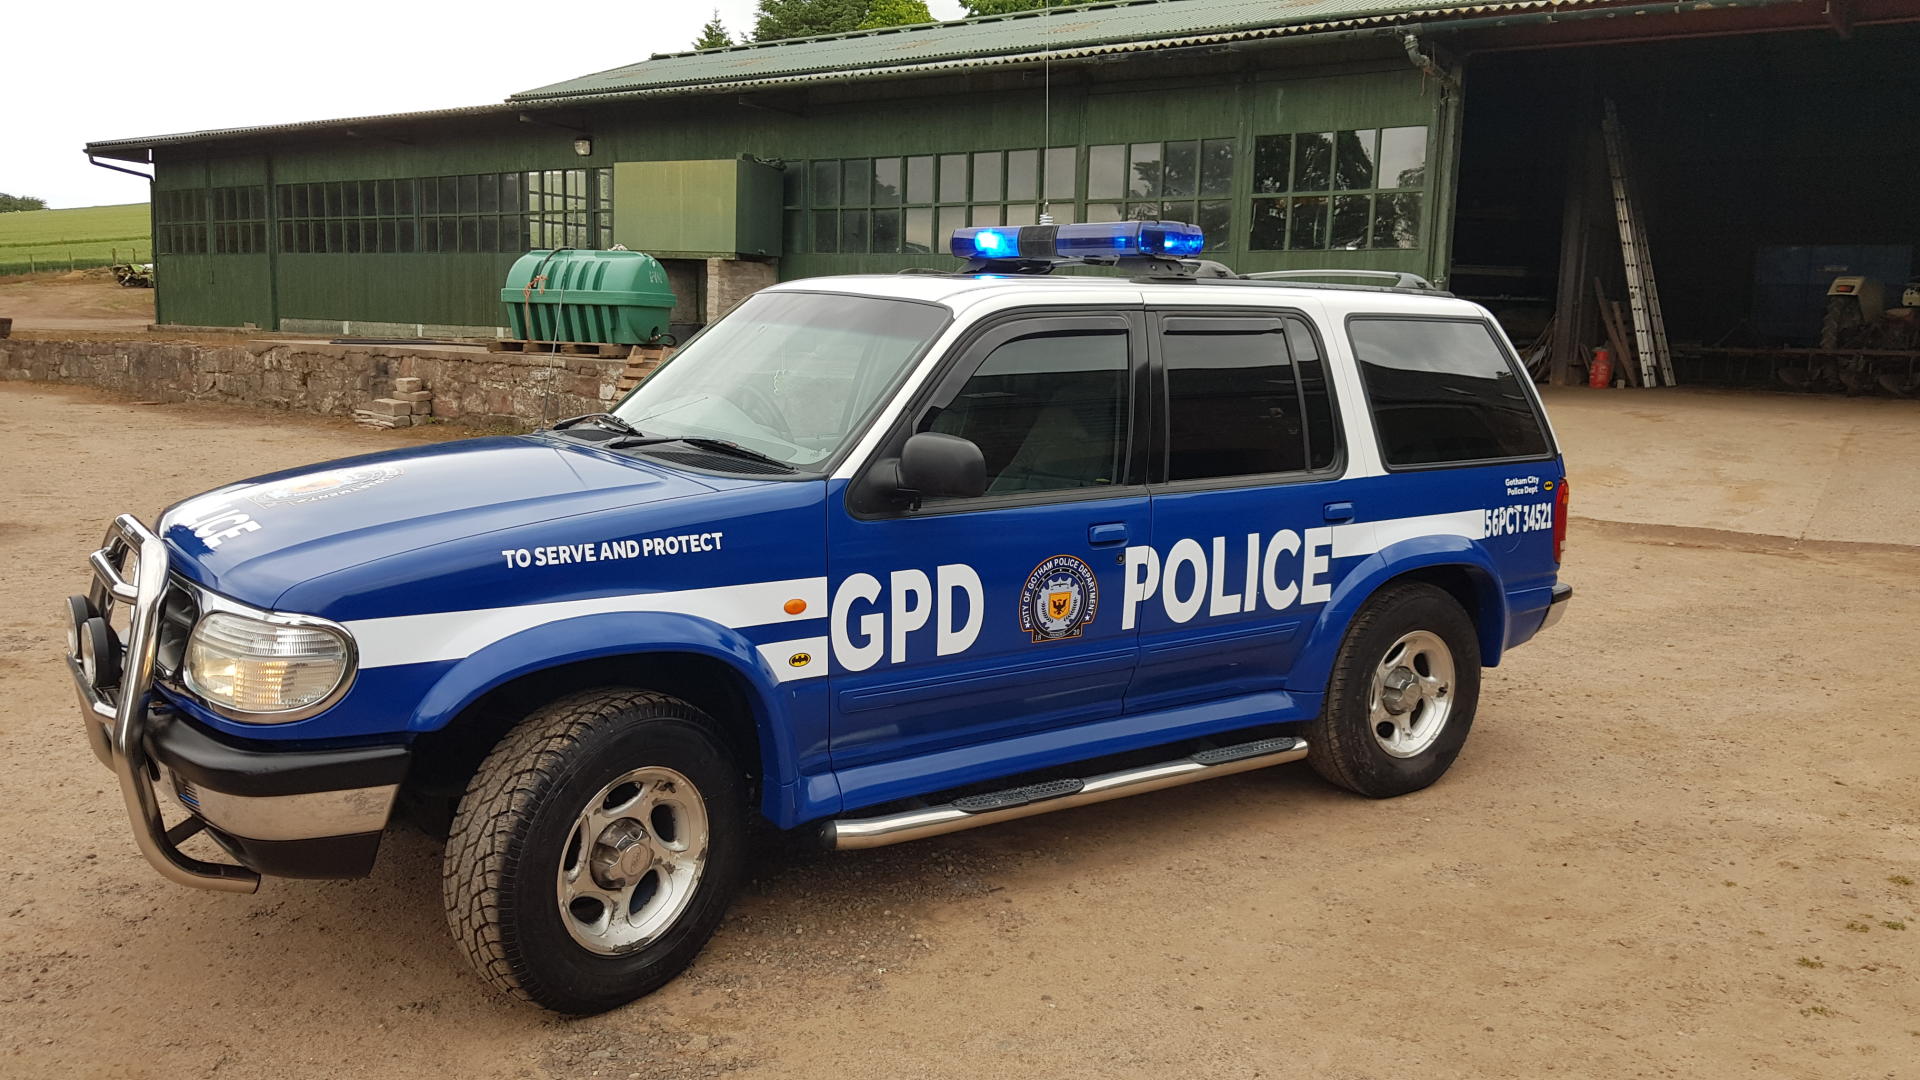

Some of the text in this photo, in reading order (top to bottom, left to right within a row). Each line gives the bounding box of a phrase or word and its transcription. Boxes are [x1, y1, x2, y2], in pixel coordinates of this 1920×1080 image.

[1505, 475, 1540, 487] Gotham City
[1507, 487, 1524, 496] Police
[1485, 502, 1552, 538] 56PCT 34521
[502, 532, 723, 569] TO SERVE AND PROTECT
[1022, 557, 1096, 622] CITY OF GOTHAM POLICE DEPARTMENT
[1121, 527, 1332, 630] POLICE
[831, 563, 984, 672] GPD
